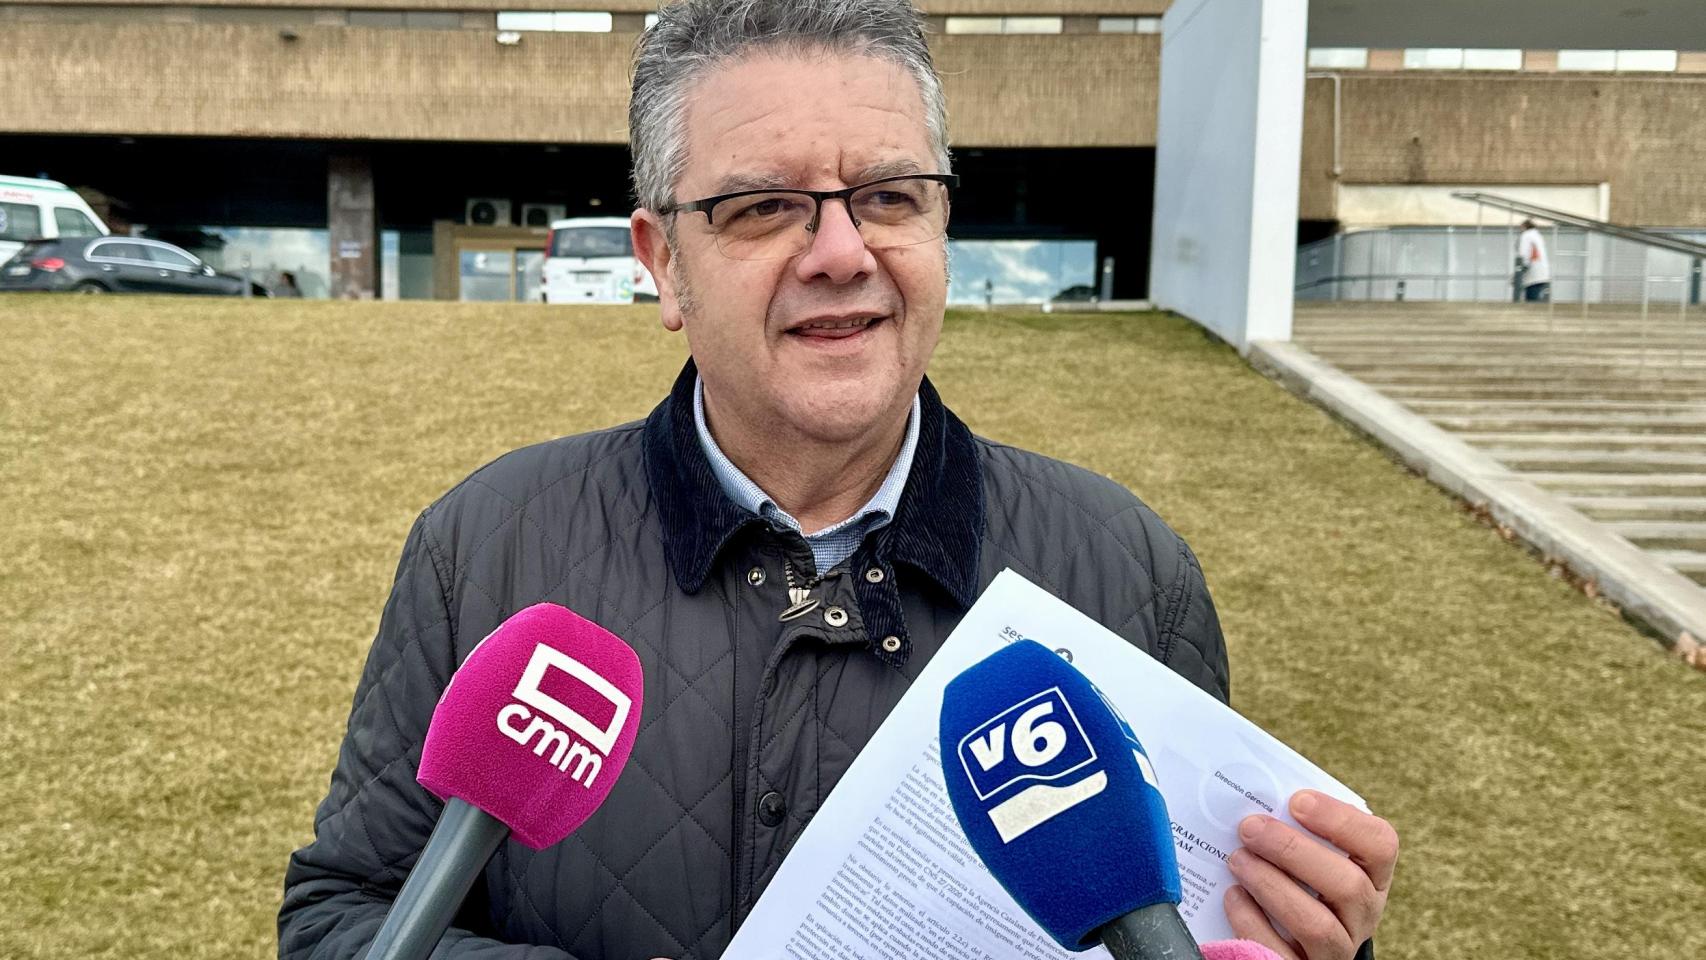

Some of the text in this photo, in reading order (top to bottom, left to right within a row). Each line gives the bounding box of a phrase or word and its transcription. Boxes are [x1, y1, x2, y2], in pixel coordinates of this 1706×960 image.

[1003, 626, 1022, 642] ses
[496, 704, 603, 789] cmm
[968, 701, 1067, 772] v6
[921, 772, 944, 792] Agencia
[1214, 770, 1274, 813] Dirección Gerencia
[975, 895, 1000, 915] Agencia
[1000, 912, 1028, 933] Catalana
